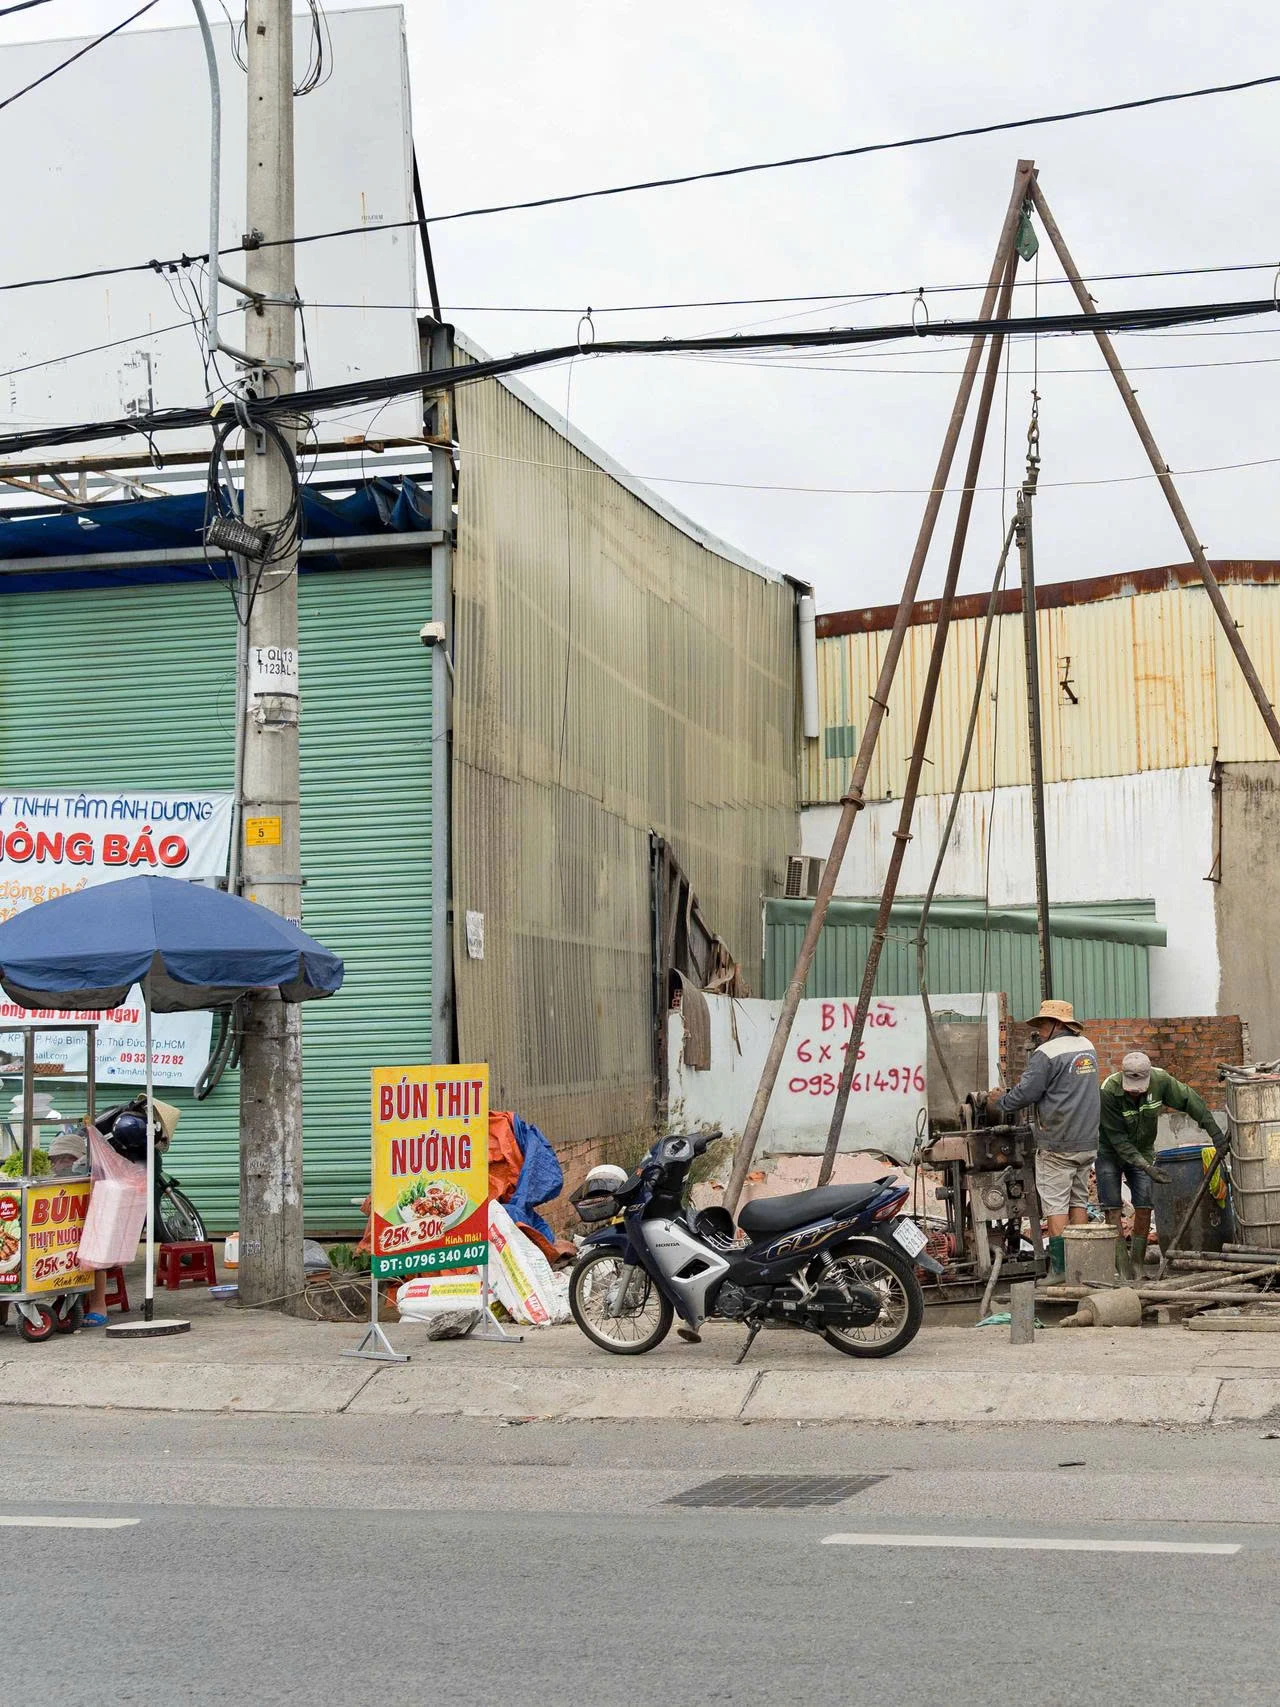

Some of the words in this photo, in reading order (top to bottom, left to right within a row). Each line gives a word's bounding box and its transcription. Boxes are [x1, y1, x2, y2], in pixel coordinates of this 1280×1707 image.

[13, 796, 59, 817] TNHH
[64, 793, 106, 820] TÂM
[111, 792, 149, 820] ÁNH
[0, 821, 94, 865] ÔNG
[102, 824, 189, 868] BÁO
[258, 828, 264, 838] 5
[822, 1004, 836, 1031] B
[797, 1039, 812, 1063] 6
[380, 1077, 428, 1122] BÚN
[435, 1081, 483, 1124] THỊT
[391, 1129, 472, 1175] NƯỚNG
[29, 1231, 55, 1253] THỊT
[380, 1258, 402, 1272] ĐT:
[405, 1252, 436, 1268] 0796
[439, 1249, 461, 1264] 340
[464, 1245, 486, 1260] 407
